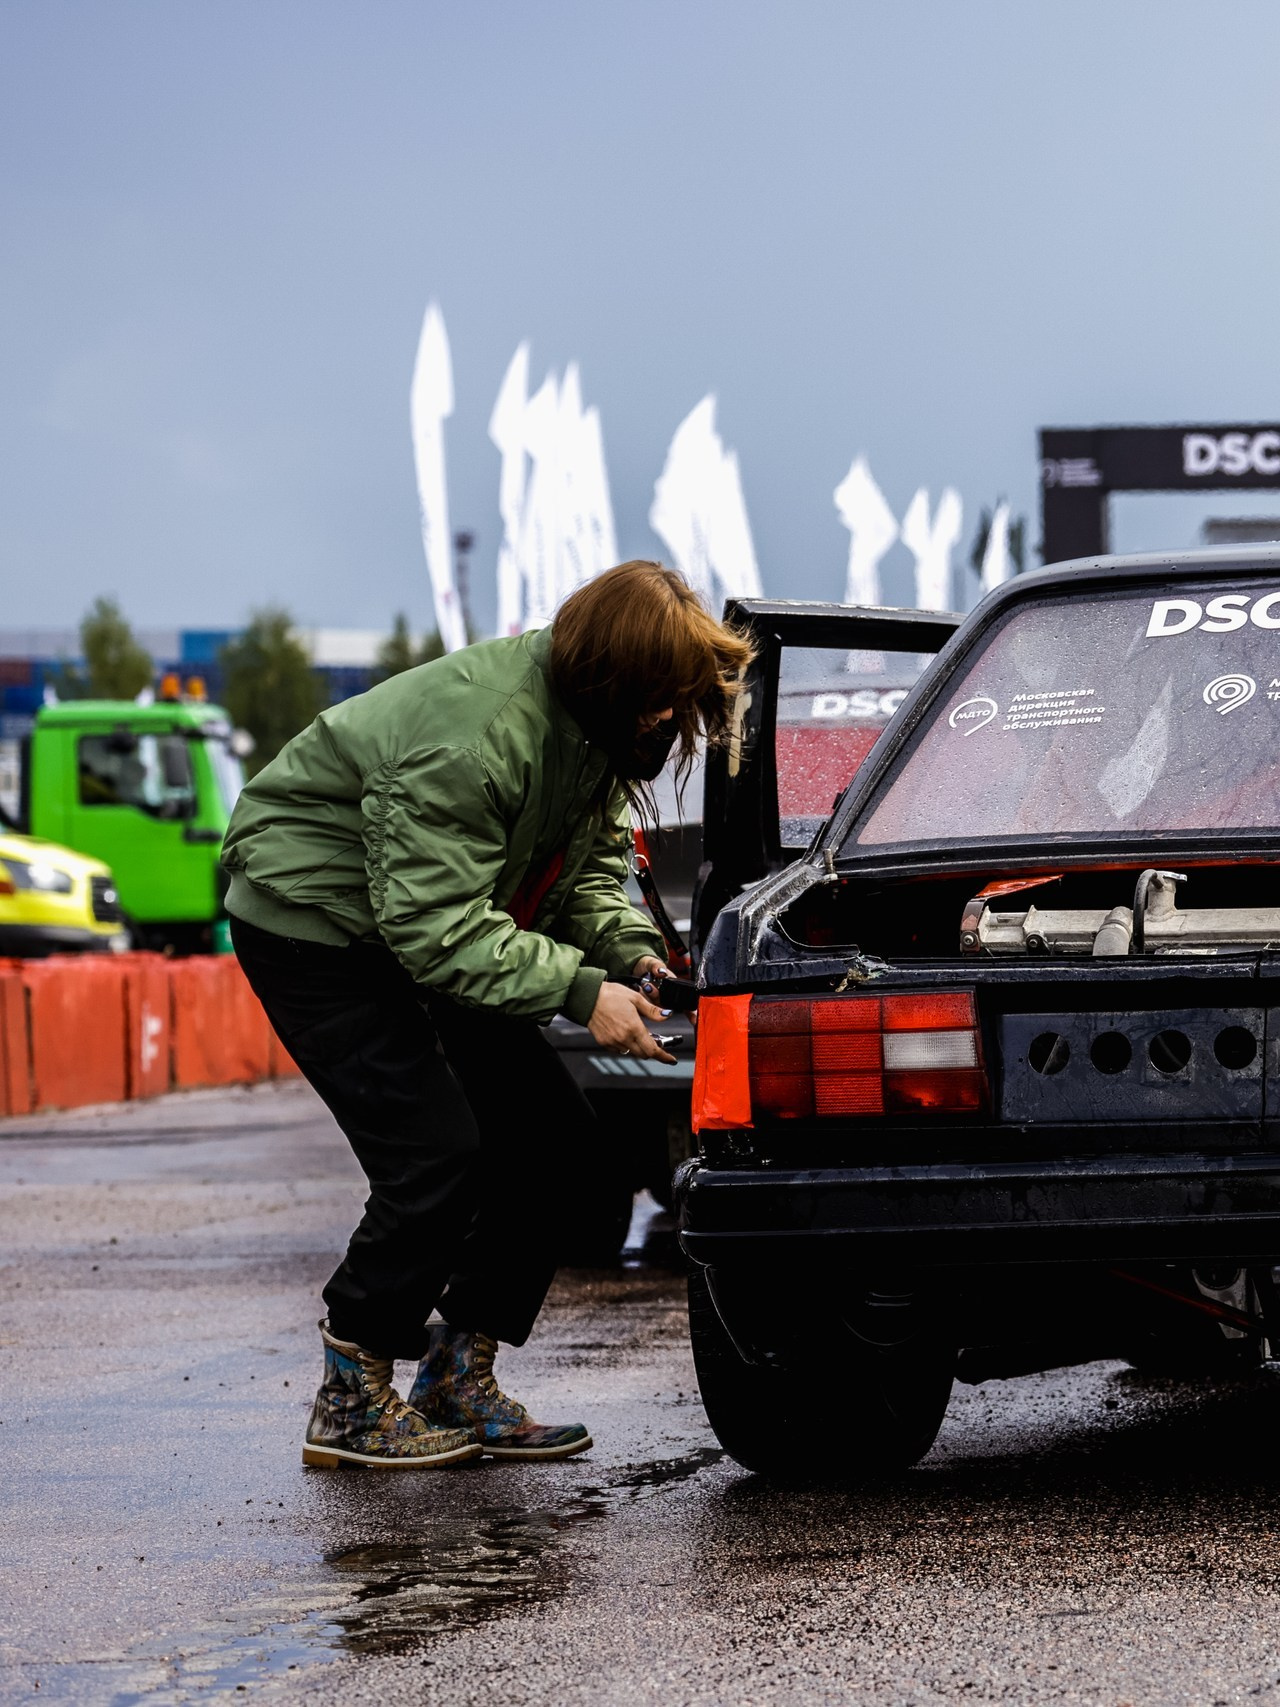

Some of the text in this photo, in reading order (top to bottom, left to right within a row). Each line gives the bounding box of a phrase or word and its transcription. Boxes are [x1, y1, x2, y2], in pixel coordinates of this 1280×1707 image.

[1012, 688, 1095, 702] Московская
[1007, 699, 1076, 713] дирекция
[956, 709, 991, 720] МДТО
[1006, 706, 1105, 722] транспортного
[1002, 716, 1102, 731] обслуживания
